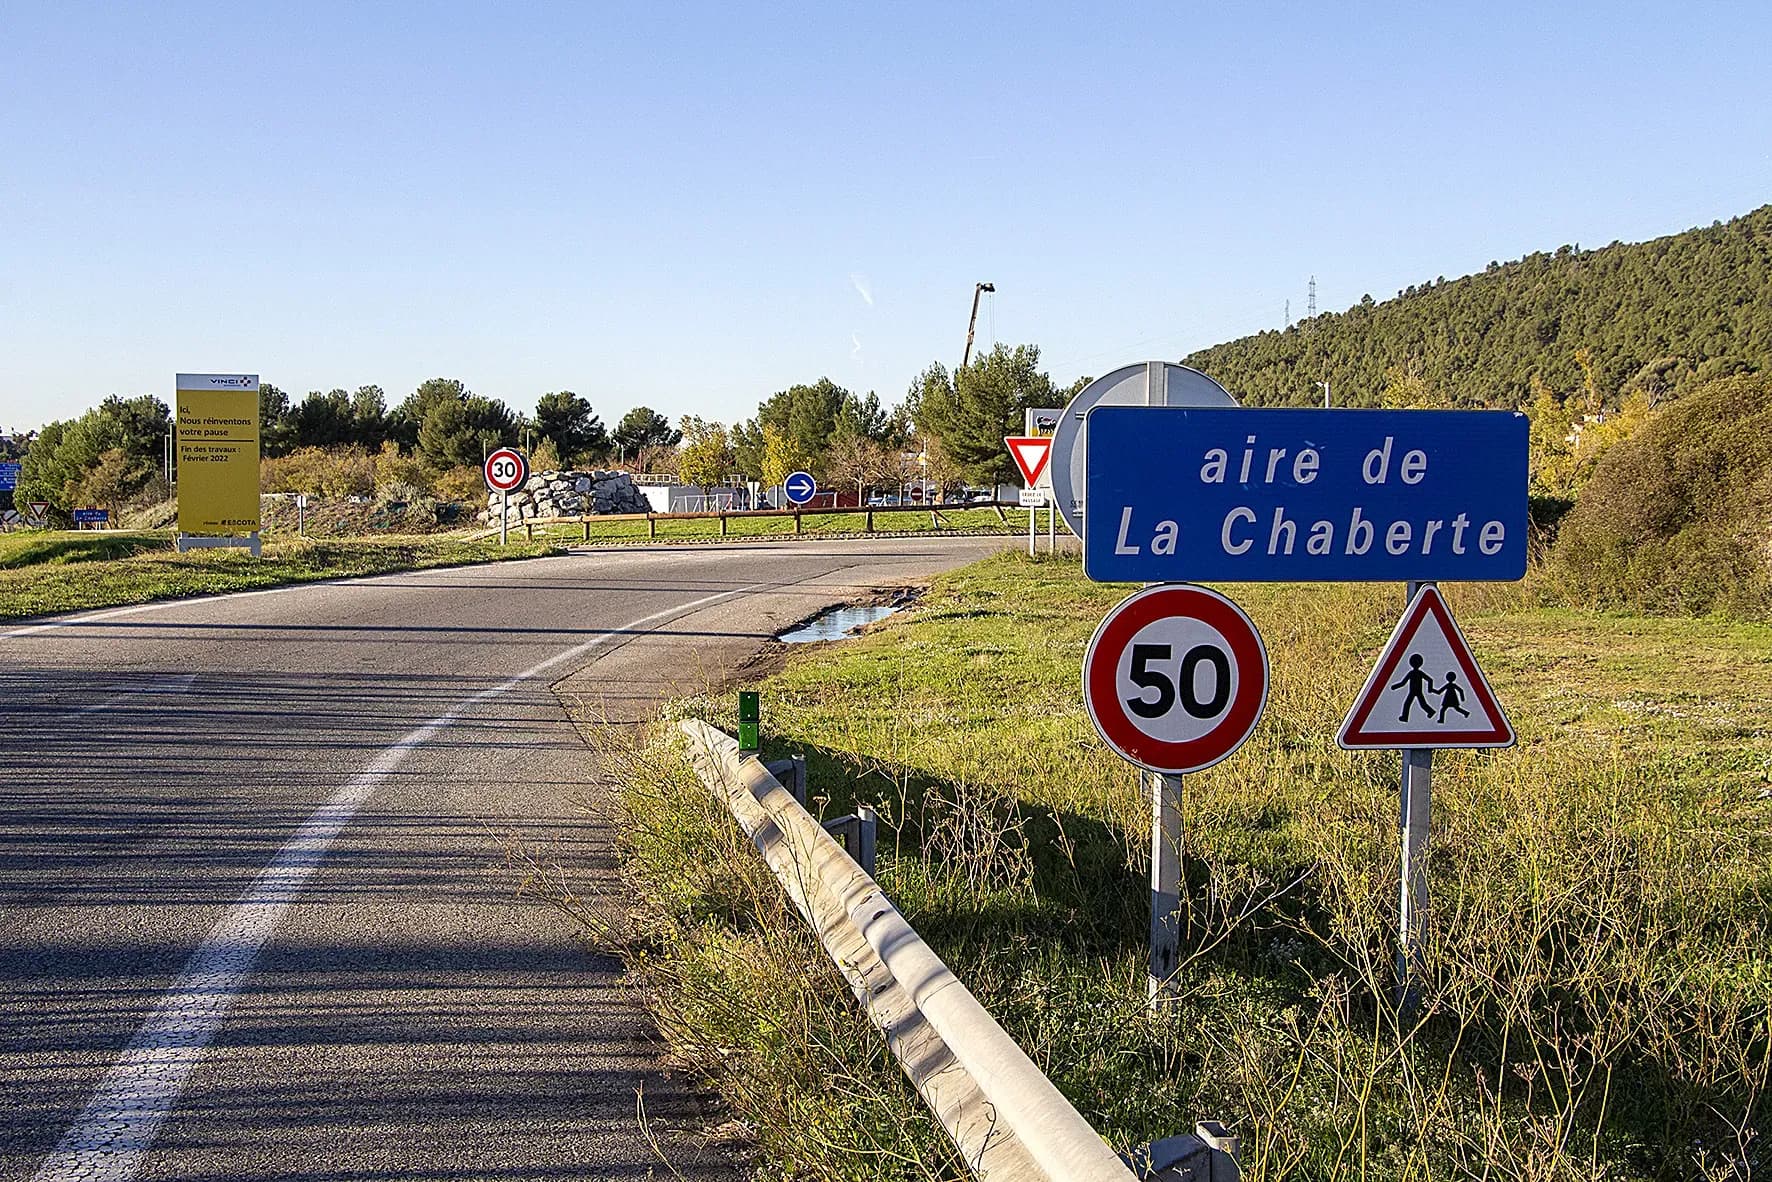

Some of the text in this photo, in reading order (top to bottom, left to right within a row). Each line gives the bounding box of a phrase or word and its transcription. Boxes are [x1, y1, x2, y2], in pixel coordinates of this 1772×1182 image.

[179, 406, 191, 415] Ici,
[180, 416, 252, 425] Nous réinventons
[204, 429, 229, 437] pause
[181, 445, 192, 453] Fin
[193, 445, 207, 453] des
[183, 454, 229, 462] Février 2022
[1200, 435, 1427, 484] aire de
[494, 462, 516, 478] 30
[1114, 506, 1505, 555] La Chaberte
[1126, 644, 1231, 719] 50
